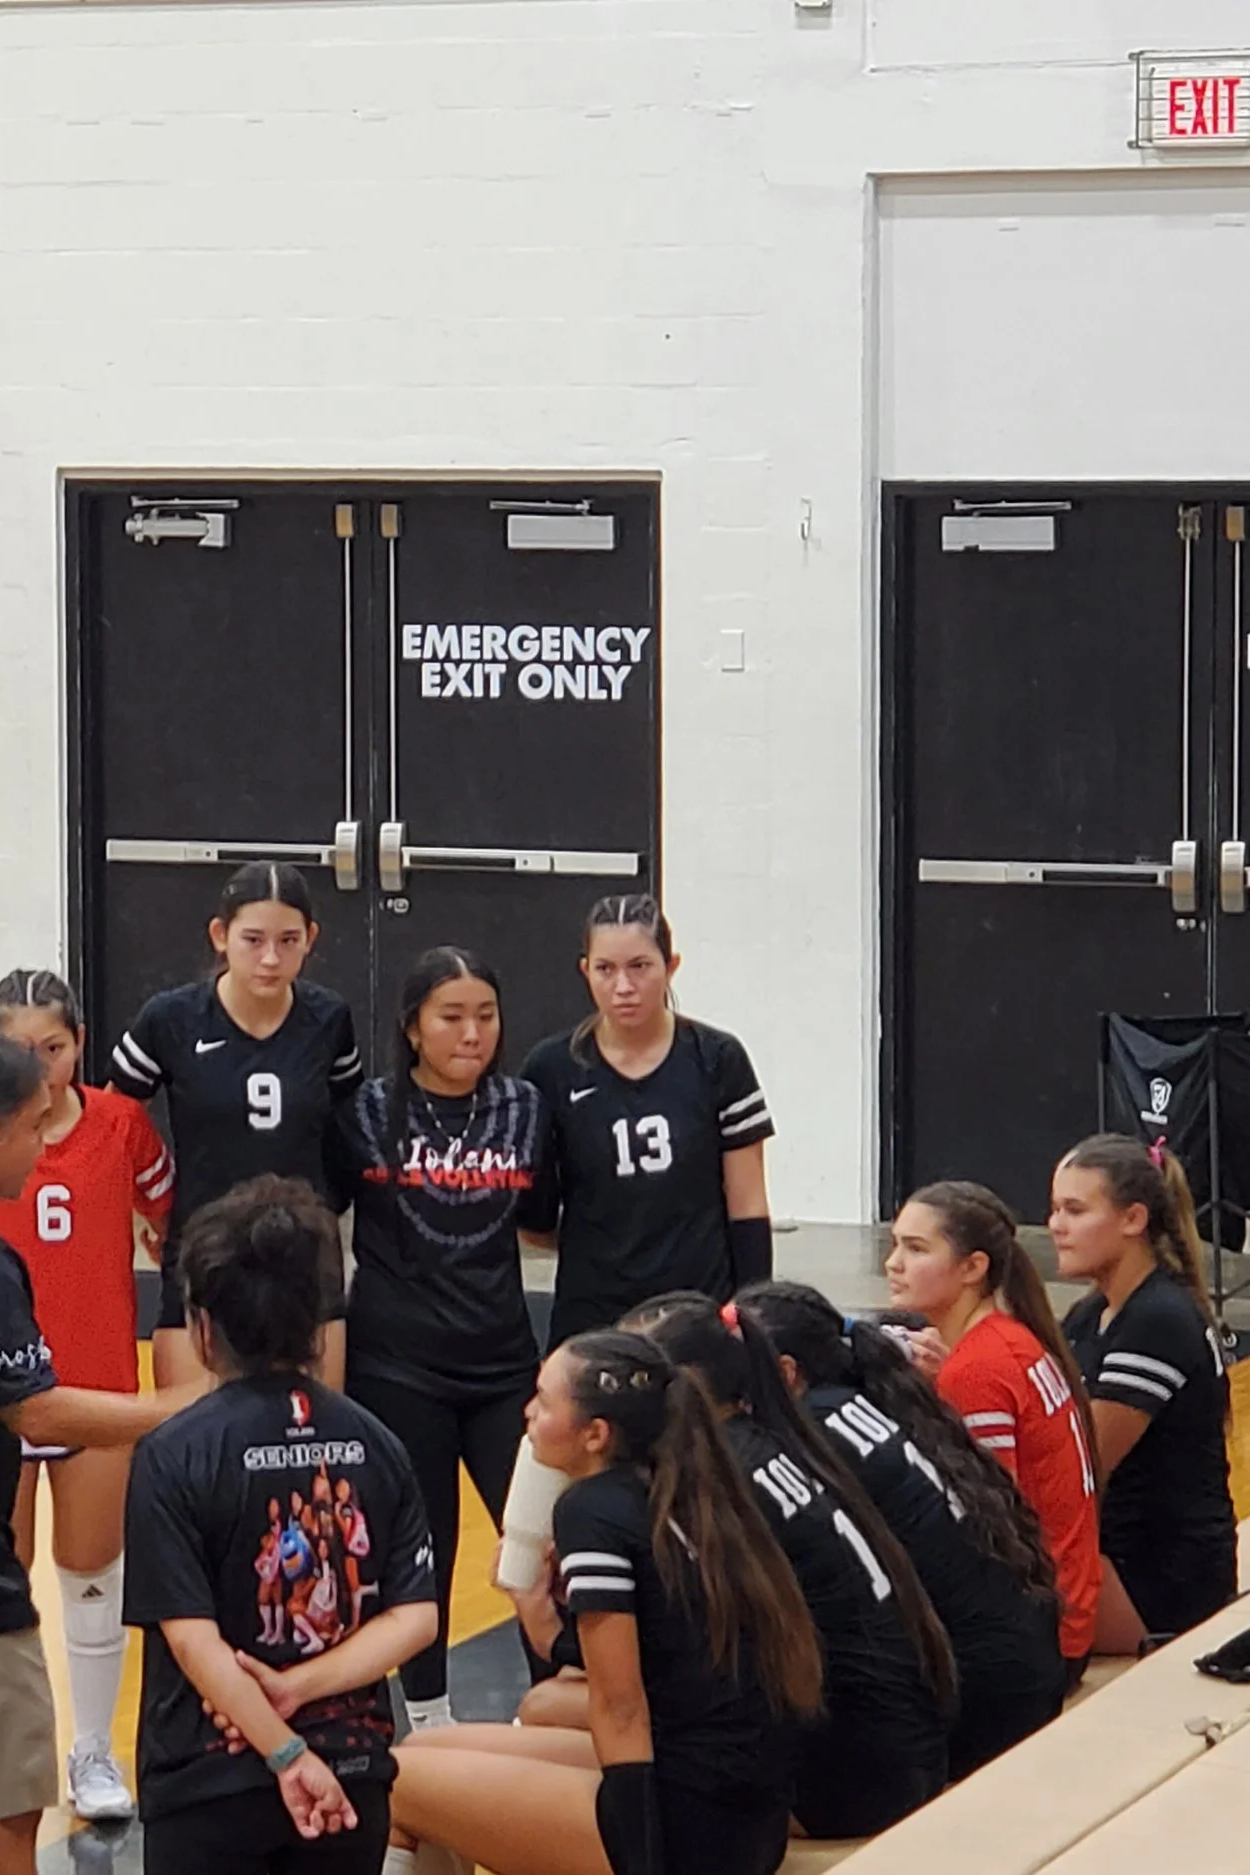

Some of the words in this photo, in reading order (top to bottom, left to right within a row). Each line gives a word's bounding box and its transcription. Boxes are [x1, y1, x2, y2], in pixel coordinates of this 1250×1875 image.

[1168, 76, 1241, 136] EXIT
[402, 624, 651, 663] EMERGENCY
[421, 661, 507, 698] EXIT
[517, 662, 632, 701] ONLY
[247, 1072, 282, 1130] 9
[612, 1113, 673, 1177] 13
[36, 1184, 72, 1242] 6
[1026, 1350, 1071, 1417] IOL
[242, 1440, 366, 1472] SENIORS
[752, 1452, 825, 1520] IOL
